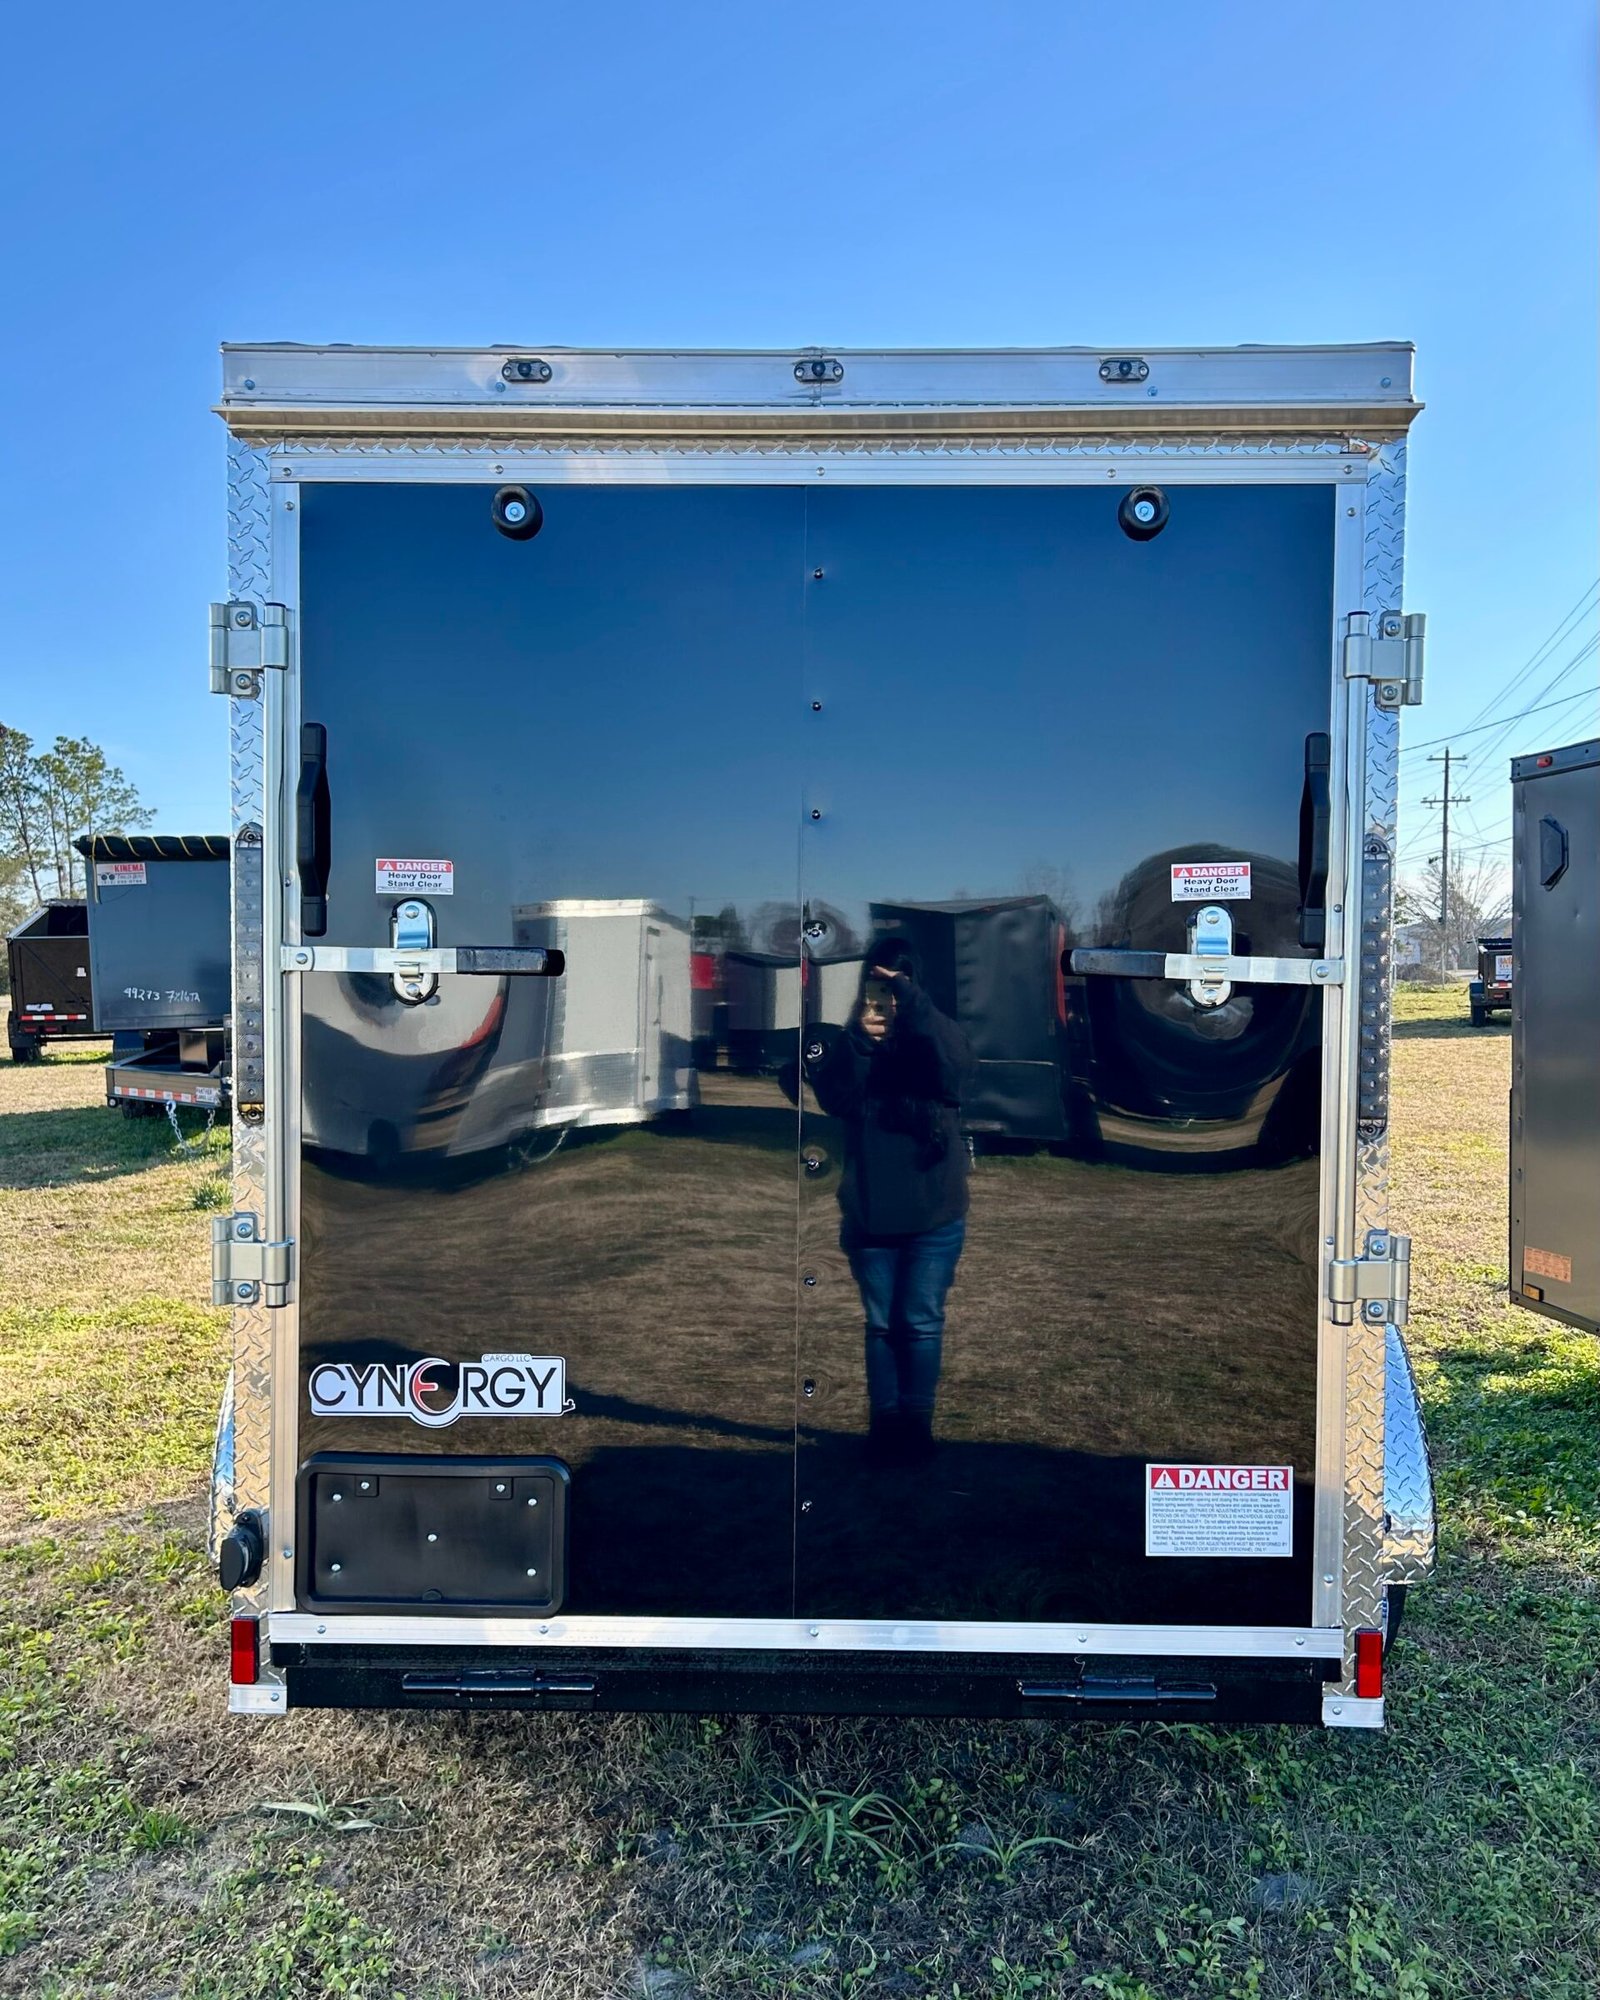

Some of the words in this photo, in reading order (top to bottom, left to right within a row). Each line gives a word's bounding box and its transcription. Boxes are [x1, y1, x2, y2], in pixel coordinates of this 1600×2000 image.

[396, 862, 447, 872] DANGER
[1192, 866, 1244, 876] DANGER
[388, 872, 417, 880] Heavy
[1184, 878, 1213, 886] Heavy
[483, 1354, 514, 1362] CARGO
[515, 1355, 531, 1363] LLC
[311, 1359, 557, 1414] CYNERGY
[1178, 1469, 1286, 1489] DANGER
